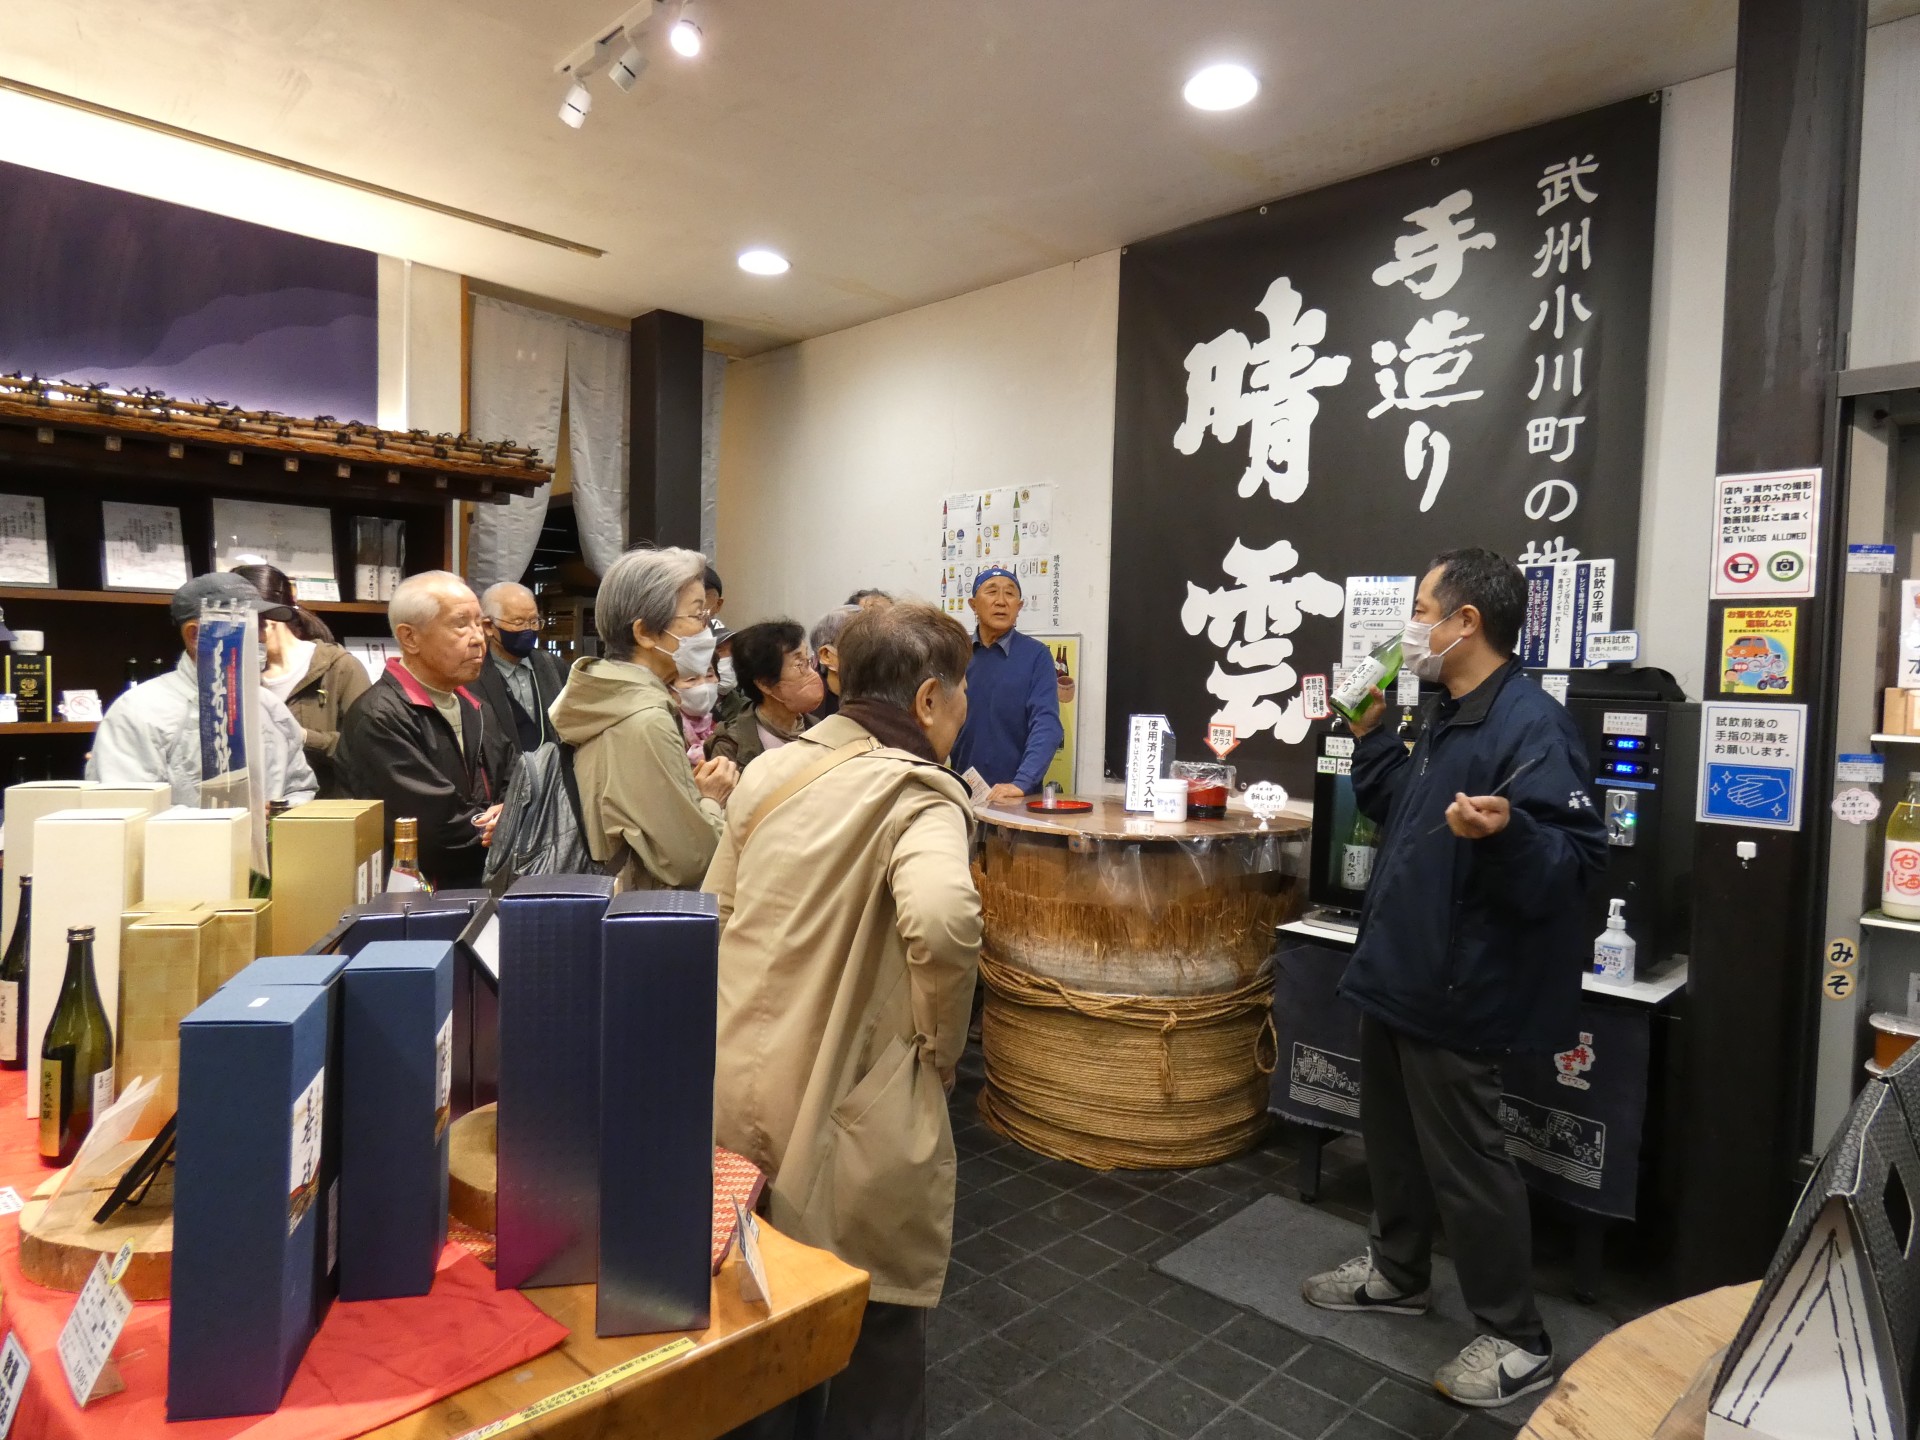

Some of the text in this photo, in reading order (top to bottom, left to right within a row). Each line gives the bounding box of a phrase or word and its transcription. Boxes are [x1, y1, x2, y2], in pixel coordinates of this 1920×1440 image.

[1367, 188, 1496, 512] 手造り
[1723, 491, 1811, 505] は、写真のみ許可し
[1173, 276, 1351, 745] 晴雲
[1723, 504, 1776, 514] ております。
[1722, 512, 1809, 525] 動画撮影はご遠慮く
[1722, 525, 1755, 534] ださい。
[1723, 532, 1807, 544] NO VIDEOS ALLOWED
[1590, 567, 1607, 623] 試飲の手順
[1352, 607, 1393, 616] 要チェック
[1745, 619, 1792, 628] 運転しない
[1593, 635, 1631, 645] 無料試飲
[1715, 716, 1779, 729] 試飲前後の
[1212, 729, 1232, 738] 使用済
[1715, 729, 1789, 744] 手指の消毒を
[1212, 737, 1231, 746] グラス
[1714, 743, 1790, 758] お願いします。
[1143, 719, 1159, 808] 使用済グラス入れ
[1895, 854, 1920, 889] 甘酒
[1827, 943, 1854, 995] みそ
